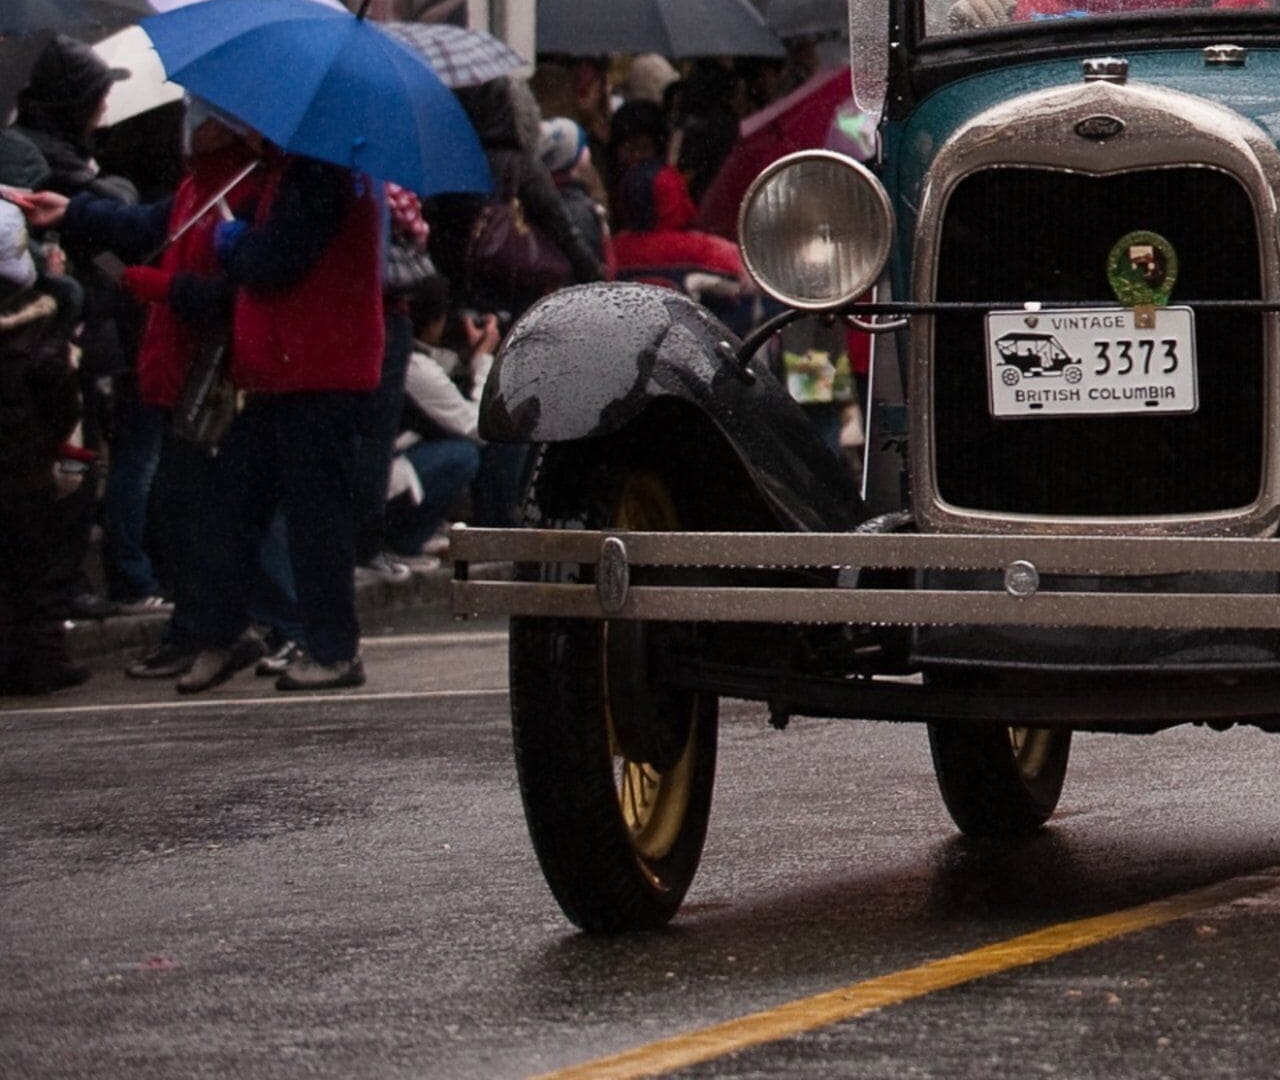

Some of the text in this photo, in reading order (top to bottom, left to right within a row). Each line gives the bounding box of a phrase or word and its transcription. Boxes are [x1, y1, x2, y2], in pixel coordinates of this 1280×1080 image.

[1052, 316, 1126, 330] VINTAGE
[1094, 339, 1178, 376] 3373
[1015, 385, 1176, 403] BRITISH COLUMBIA
